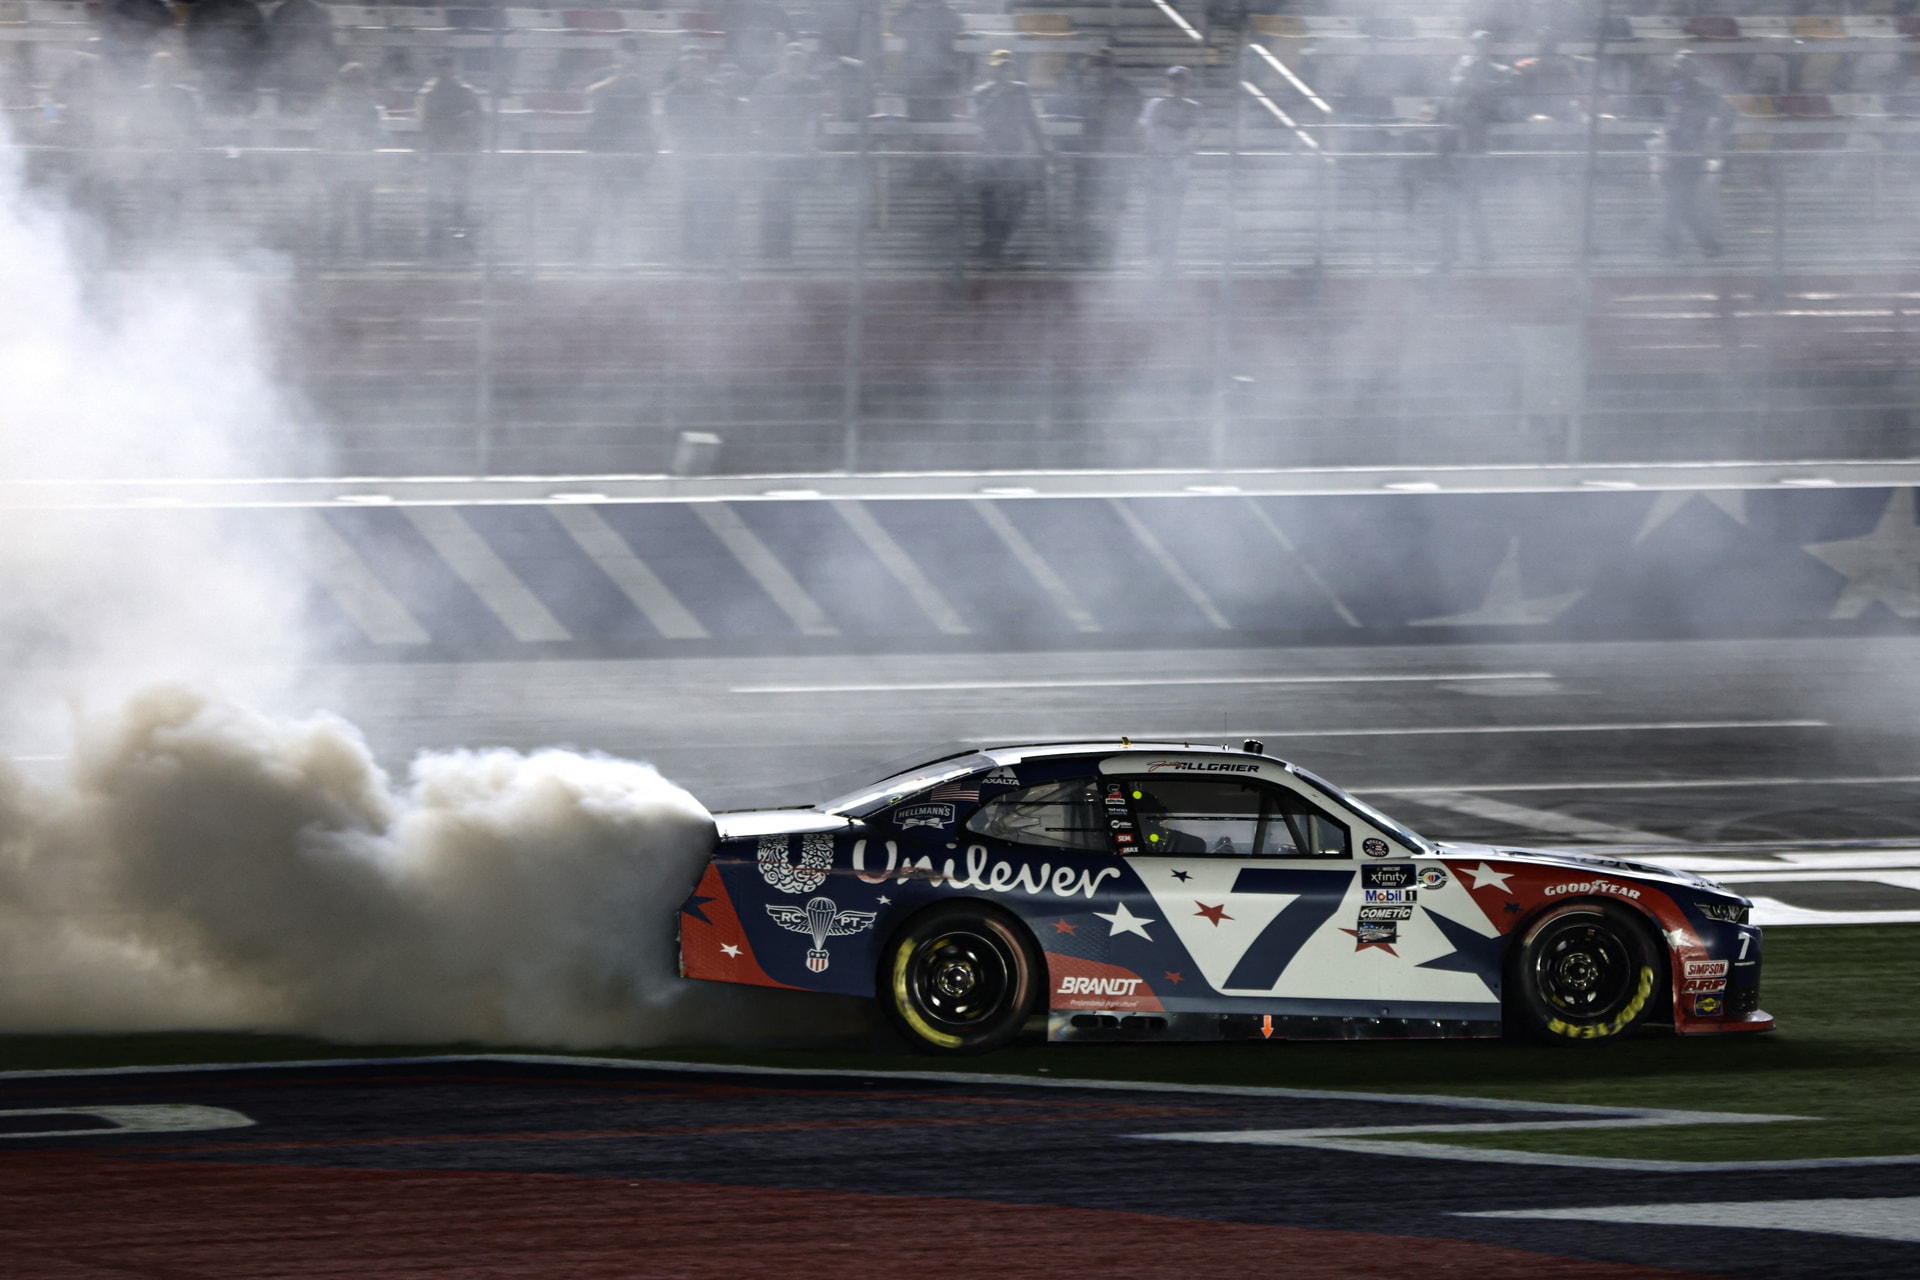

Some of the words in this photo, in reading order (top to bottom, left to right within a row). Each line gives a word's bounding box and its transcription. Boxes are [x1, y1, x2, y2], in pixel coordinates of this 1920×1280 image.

[1175, 762, 1260, 773] ALLGAIER
[982, 778, 1020, 786] AXALTA
[898, 805, 951, 818] HELLMANN'S
[853, 839, 1120, 898] Unilever
[1371, 872, 1407, 884] xfinity
[1365, 890, 1402, 901] Mobil
[1360, 907, 1411, 918] COMETIC
[781, 912, 801, 922] RC
[841, 917, 860, 927] PT
[1222, 868, 1357, 991] 7
[1738, 932, 1751, 960] 7
[1688, 963, 1725, 976] SIMPSON
[1057, 977, 1143, 996] BRANDT
[1683, 979, 1726, 992] ARP
